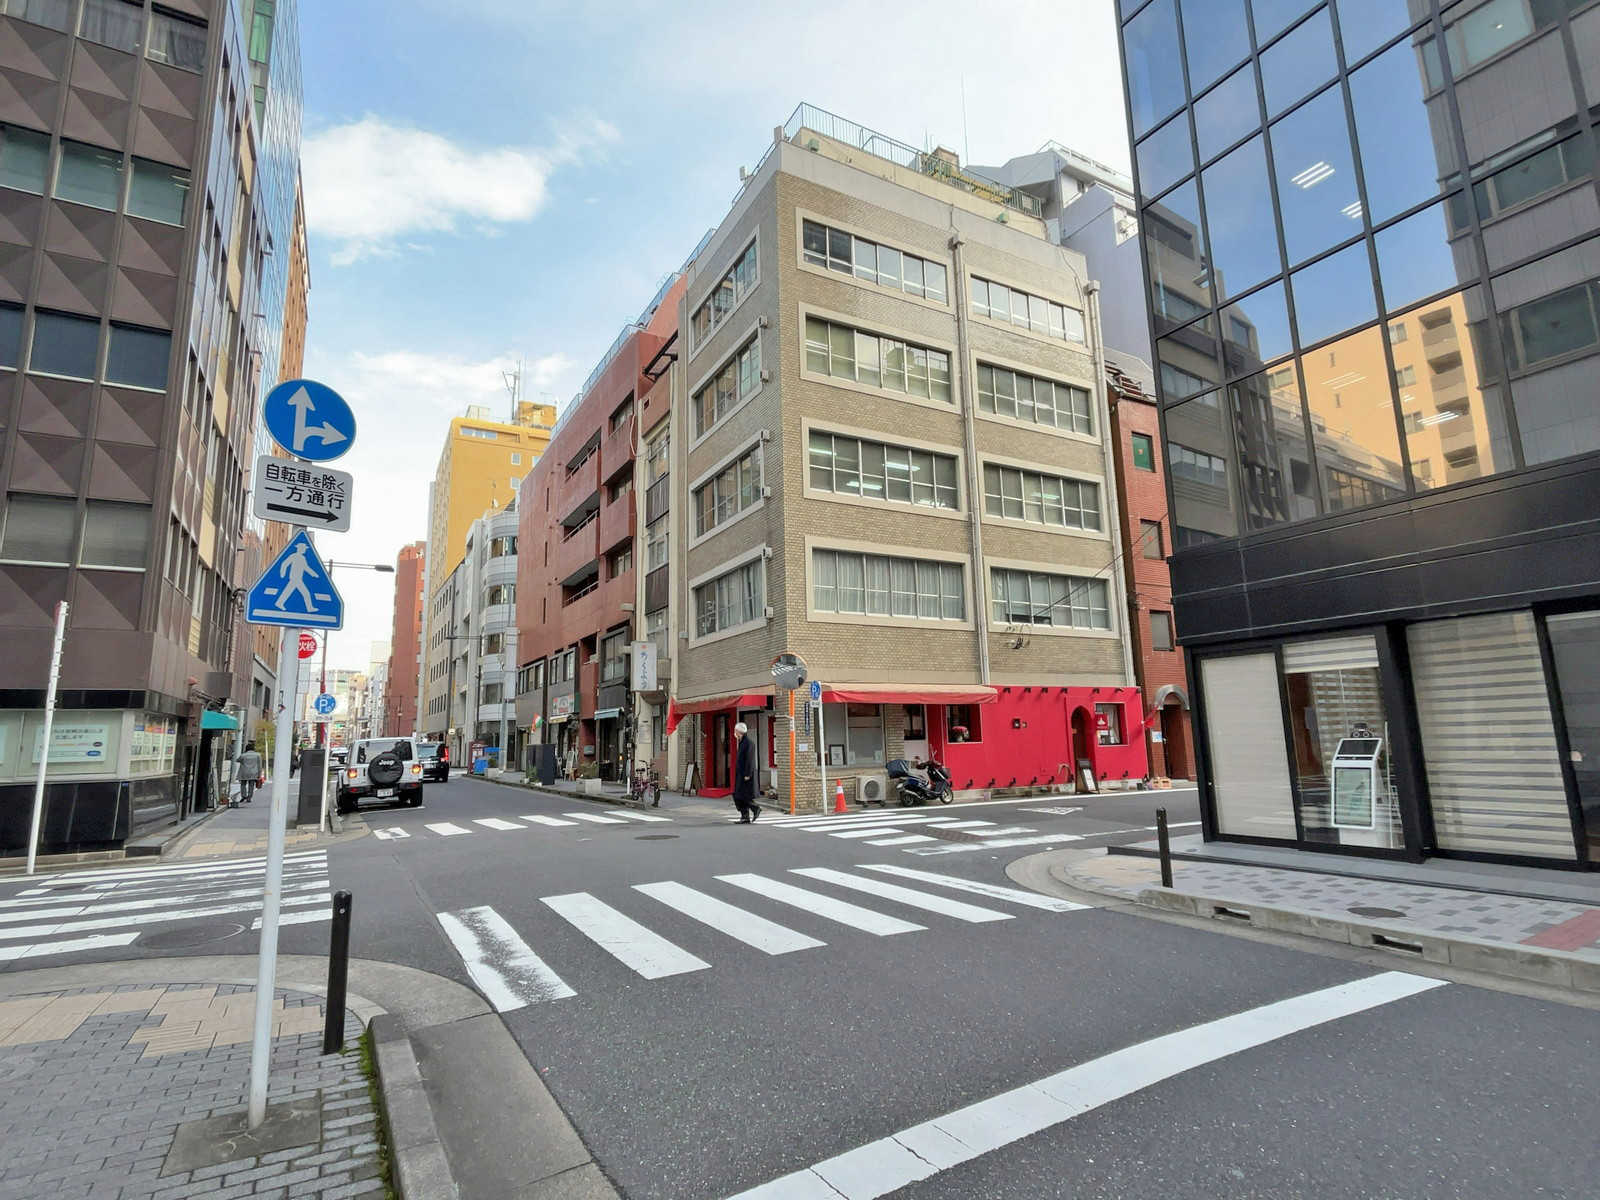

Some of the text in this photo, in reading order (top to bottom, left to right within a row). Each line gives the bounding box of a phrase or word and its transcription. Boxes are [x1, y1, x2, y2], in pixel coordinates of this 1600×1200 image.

[266, 463, 345, 493] 自転車を除く
[264, 486, 345, 510] 一方通行
[298, 641, 316, 652] 火栓
[319, 699, 328, 712] P
